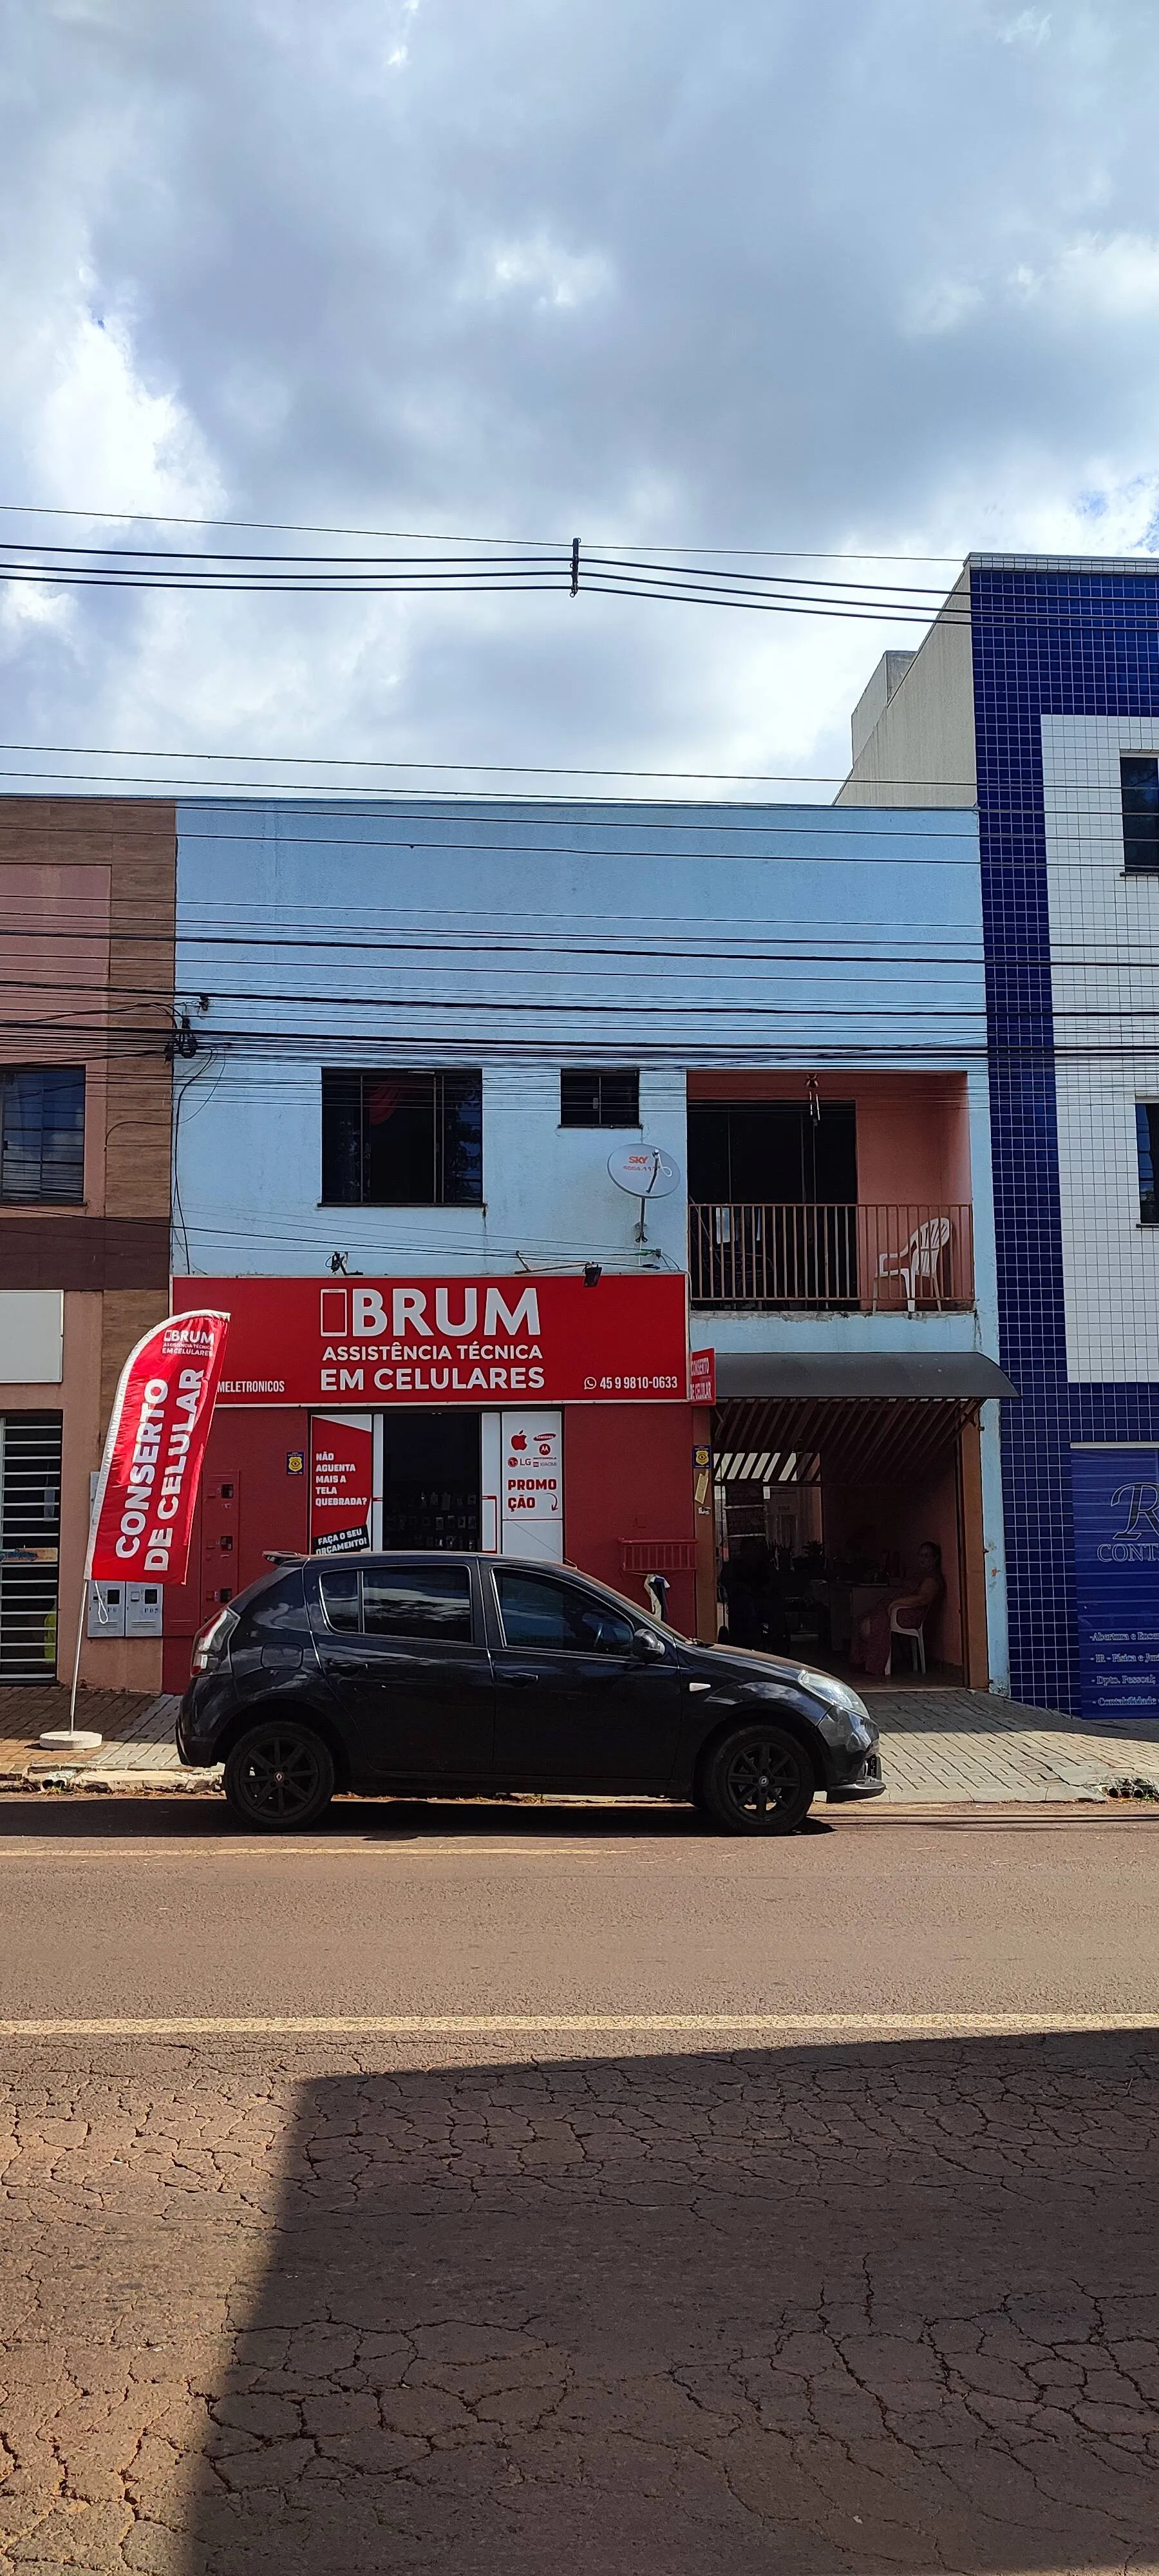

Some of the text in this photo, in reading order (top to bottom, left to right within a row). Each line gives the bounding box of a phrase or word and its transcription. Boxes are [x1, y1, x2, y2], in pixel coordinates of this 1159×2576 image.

[352, 1288, 541, 1336] BRUM
[171, 1329, 214, 1344] BRUM
[174, 1348, 213, 1357] CELULARES
[322, 1341, 543, 1361] ASSISTÊNCIA TÉCNICA
[691, 1357, 710, 1376] CONSERTO
[218, 1381, 285, 1392] MELETRONICOS
[321, 1367, 545, 1390] EM CELULARES
[599, 1376, 678, 1389] 45 9 9810-0633
[695, 1381, 711, 1399] CELULAR
[316, 1452, 334, 1461] NÃO
[520, 1458, 532, 1466] LG
[116, 1378, 168, 1558] CONSERTO
[144, 1368, 204, 1571] DE CELULAR
[316, 1464, 355, 1472] AGUENTA
[508, 1479, 557, 1491] PROMO
[315, 1497, 367, 1507] QUEBRADA?
[508, 1494, 536, 1512] ÇÃO
[318, 1534, 339, 1546] FAÇA
[346, 1528, 362, 1538] SEU
[316, 1537, 367, 1555] ORÇAMENTO!
[1097, 1543, 1159, 1562] CONT
[1095, 1654, 1106, 1663] IR
[1097, 1696, 1157, 1706] Contabilidade
